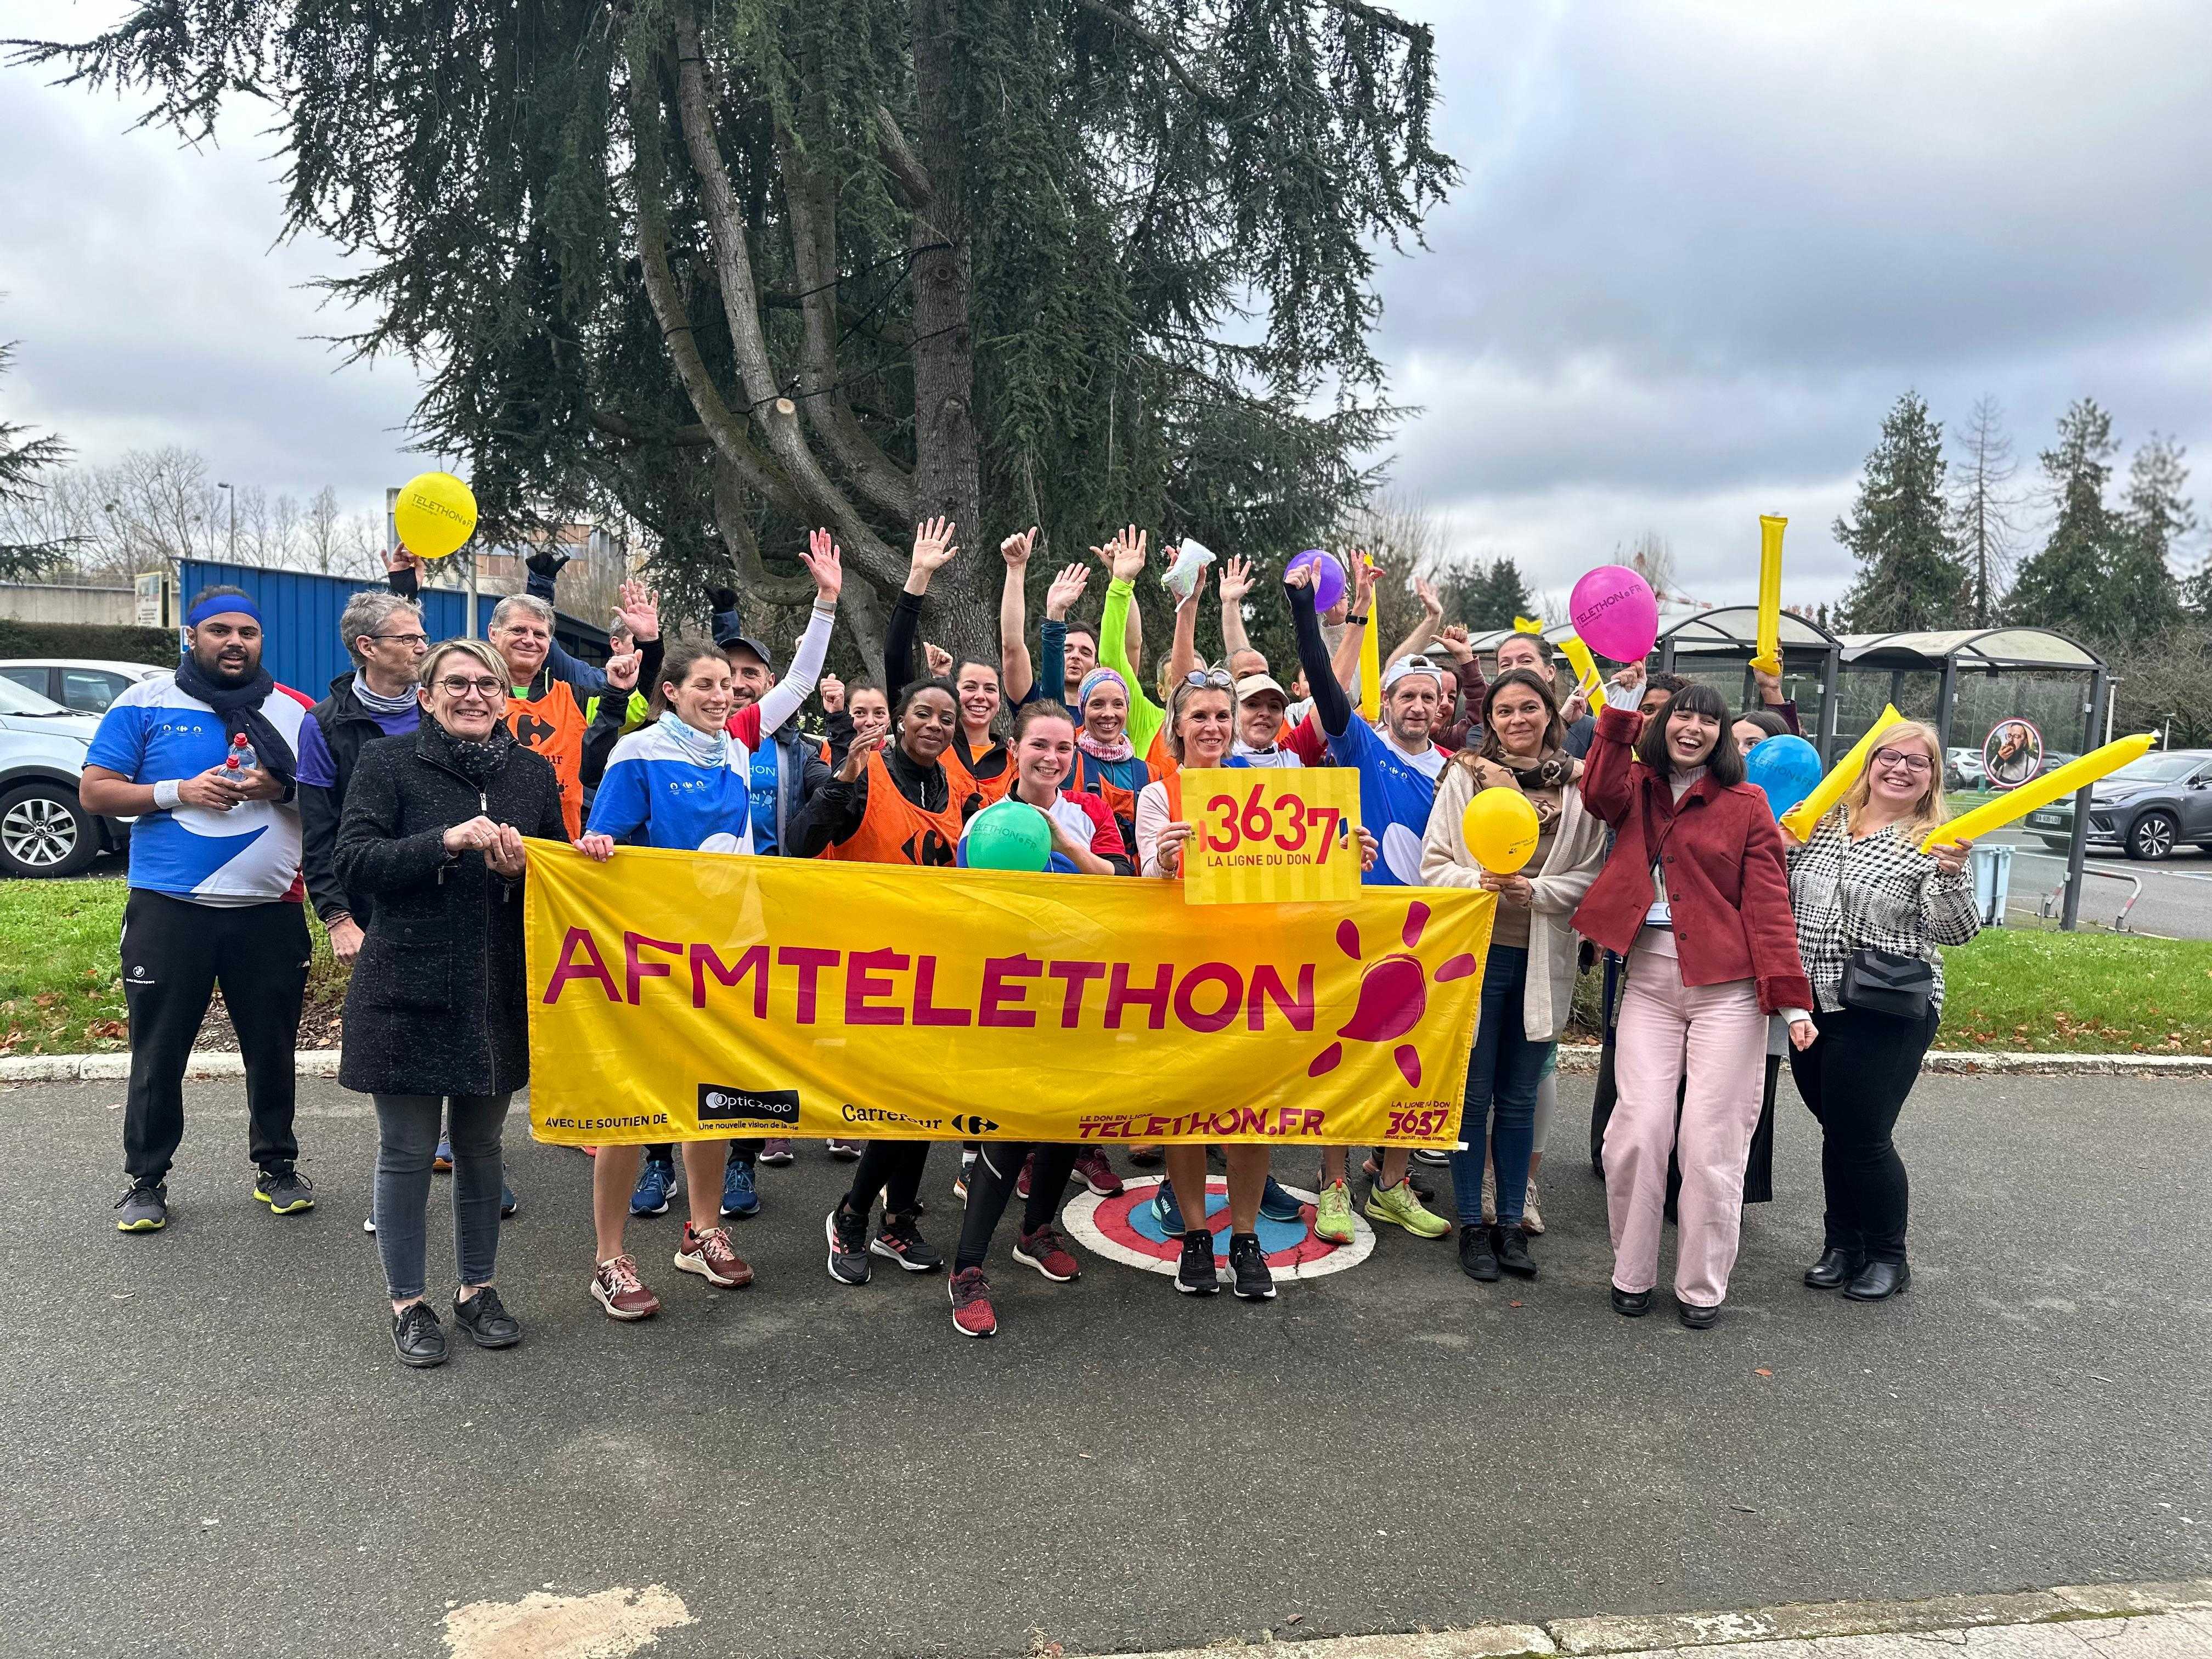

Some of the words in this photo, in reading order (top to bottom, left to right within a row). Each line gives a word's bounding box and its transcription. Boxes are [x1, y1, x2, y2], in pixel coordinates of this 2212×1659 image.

[1206, 784, 1340, 864] 3637
[1207, 856, 1223, 867] LA
[1227, 855, 1263, 866] LIGNE
[1266, 855, 1283, 865] DU
[1287, 854, 1311, 865] DON
[545, 1117, 574, 1128] AVEC
[578, 1119, 593, 1129] LE
[596, 1115, 649, 1128] SOUTIEN
[653, 1113, 668, 1125] DE
[1078, 1107, 1325, 1139] TELETHON.FR
[1385, 1109, 1448, 1136] 3637
